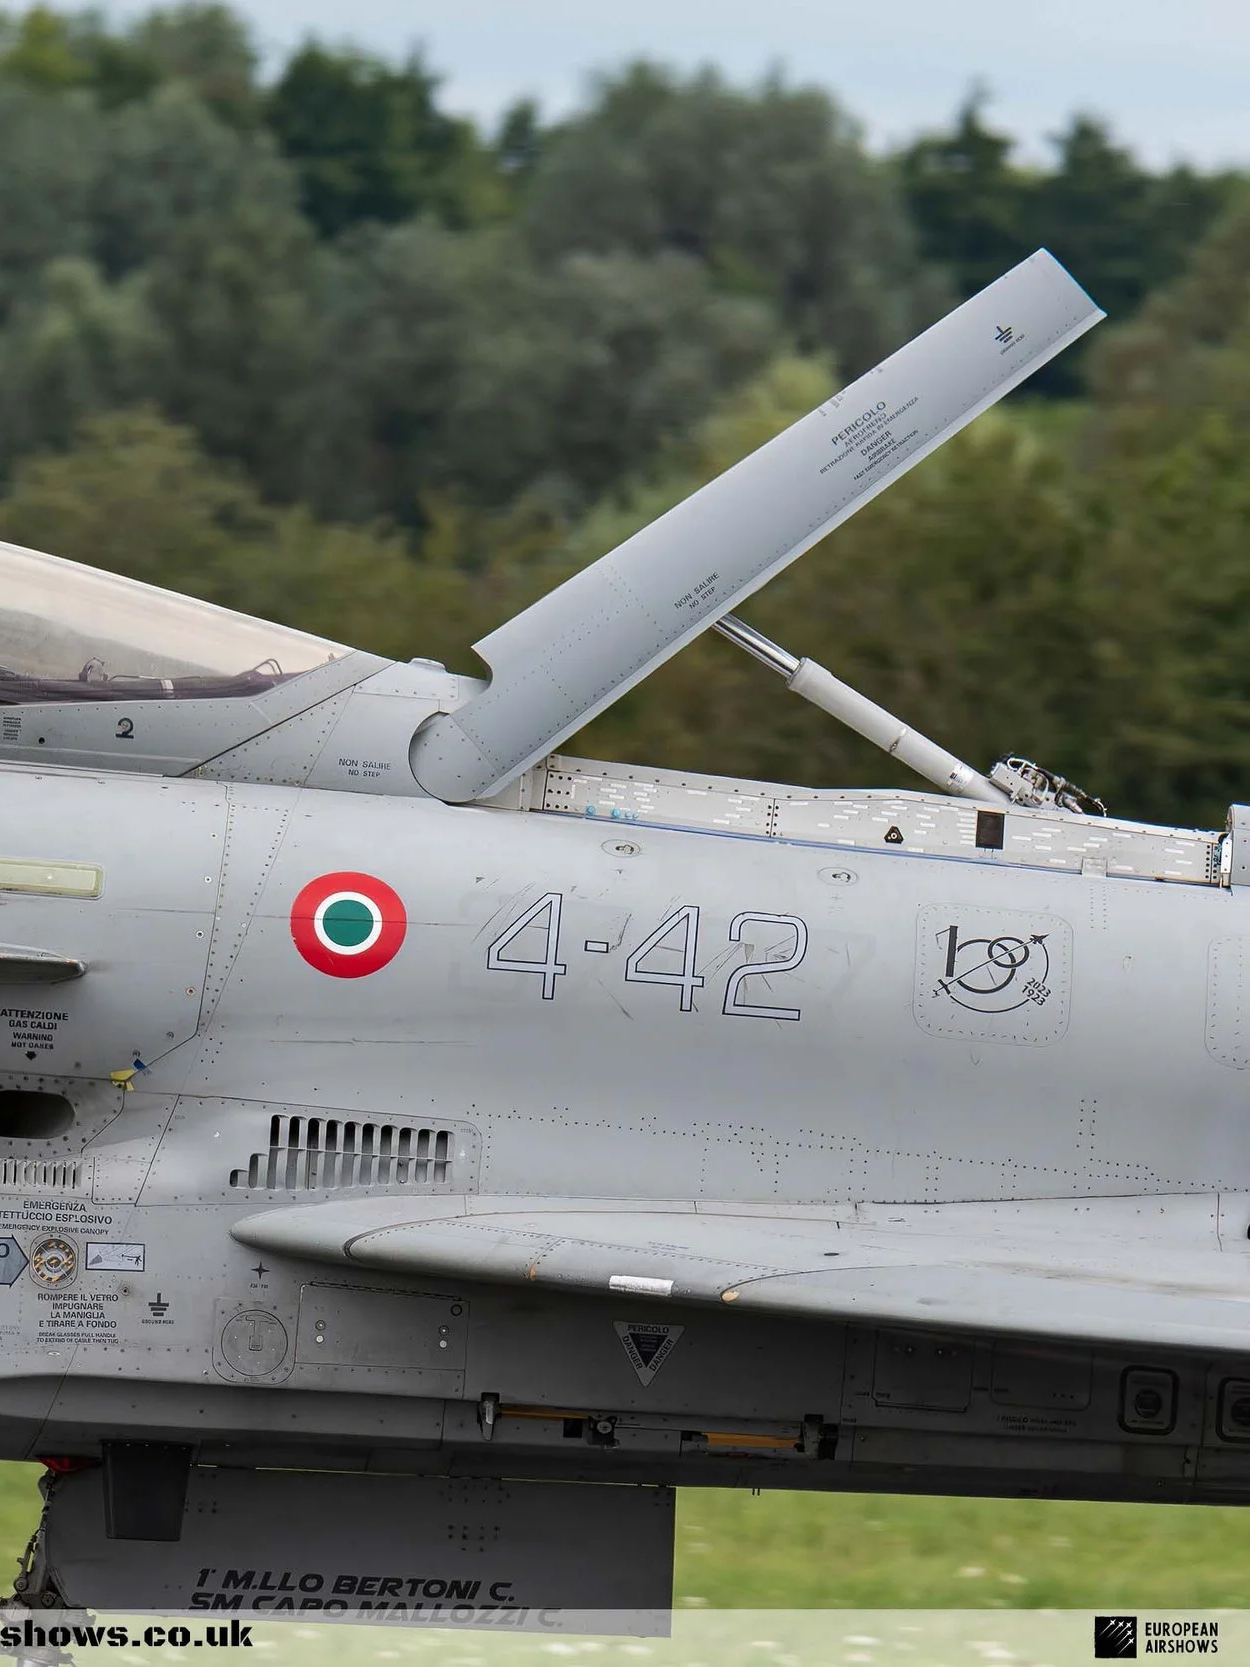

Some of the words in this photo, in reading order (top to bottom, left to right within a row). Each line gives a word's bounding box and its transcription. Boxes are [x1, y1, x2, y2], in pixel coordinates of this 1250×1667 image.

[831, 401, 886, 446] PERICOLO
[860, 430, 892, 456] DANGER
[700, 586, 716, 600] STEP
[674, 593, 693, 609] NON
[115, 717, 134, 739] 2
[338, 758, 358, 767] NON
[487, 892, 808, 1021] 4-42
[1027, 978, 1051, 998] 2023
[1022, 985, 1046, 1006] 1923
[0, 1008, 69, 1021] ATTENZIONE
[8, 1020, 28, 1028] GAS
[30, 1021, 58, 1030] CALDI
[13, 1032, 54, 1042] WARNING
[23, 1200, 86, 1212] EMERGENZA
[55, 1213, 113, 1225] ESPLOSIVO
[41, 1225, 79, 1234] EXPLOSIVE
[80, 1227, 109, 1235] CANOPY
[37, 1293, 79, 1301] ROMPERE
[80, 1293, 87, 1301] IL
[90, 1294, 119, 1302] VETRO
[52, 1302, 104, 1310] IMPUGNARE
[50, 1311, 61, 1319] LA
[62, 1311, 105, 1319] MANIGLIA
[46, 1320, 76, 1328] TIRARE
[77, 1320, 84, 1328] A
[86, 1320, 117, 1328] FONDO
[622, 1335, 643, 1370] DANGER
[221, 1569, 325, 1593] M.LLO
[331, 1575, 483, 1599] BERTONI
[489, 1582, 515, 1602] C.
[187, 1592, 246, 1613] SM
[251, 1595, 354, 1618] CAPO
[355, 1600, 529, 1627] MALLOZZI
[538, 1607, 564, 1627] C.
